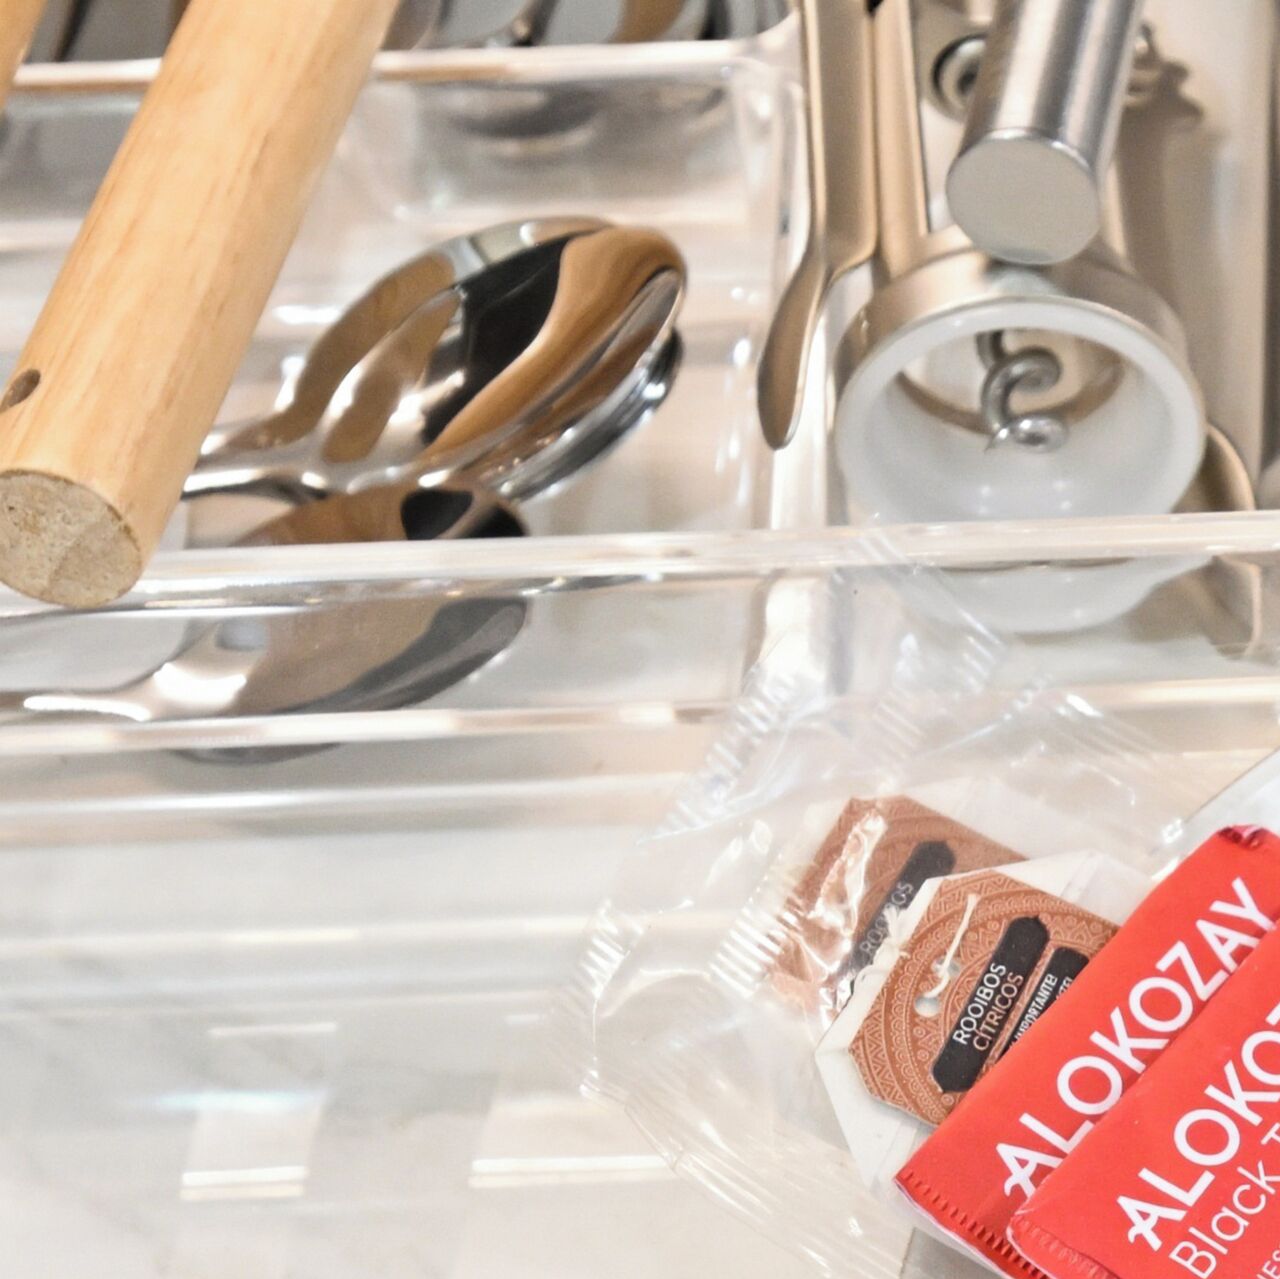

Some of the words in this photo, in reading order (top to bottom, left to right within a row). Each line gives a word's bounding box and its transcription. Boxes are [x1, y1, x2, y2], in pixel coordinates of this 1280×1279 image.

[860, 882, 914, 955] ROOOS
[952, 962, 1006, 1045] ROOIBOS
[996, 877, 1276, 1197] ALOKOZAY
